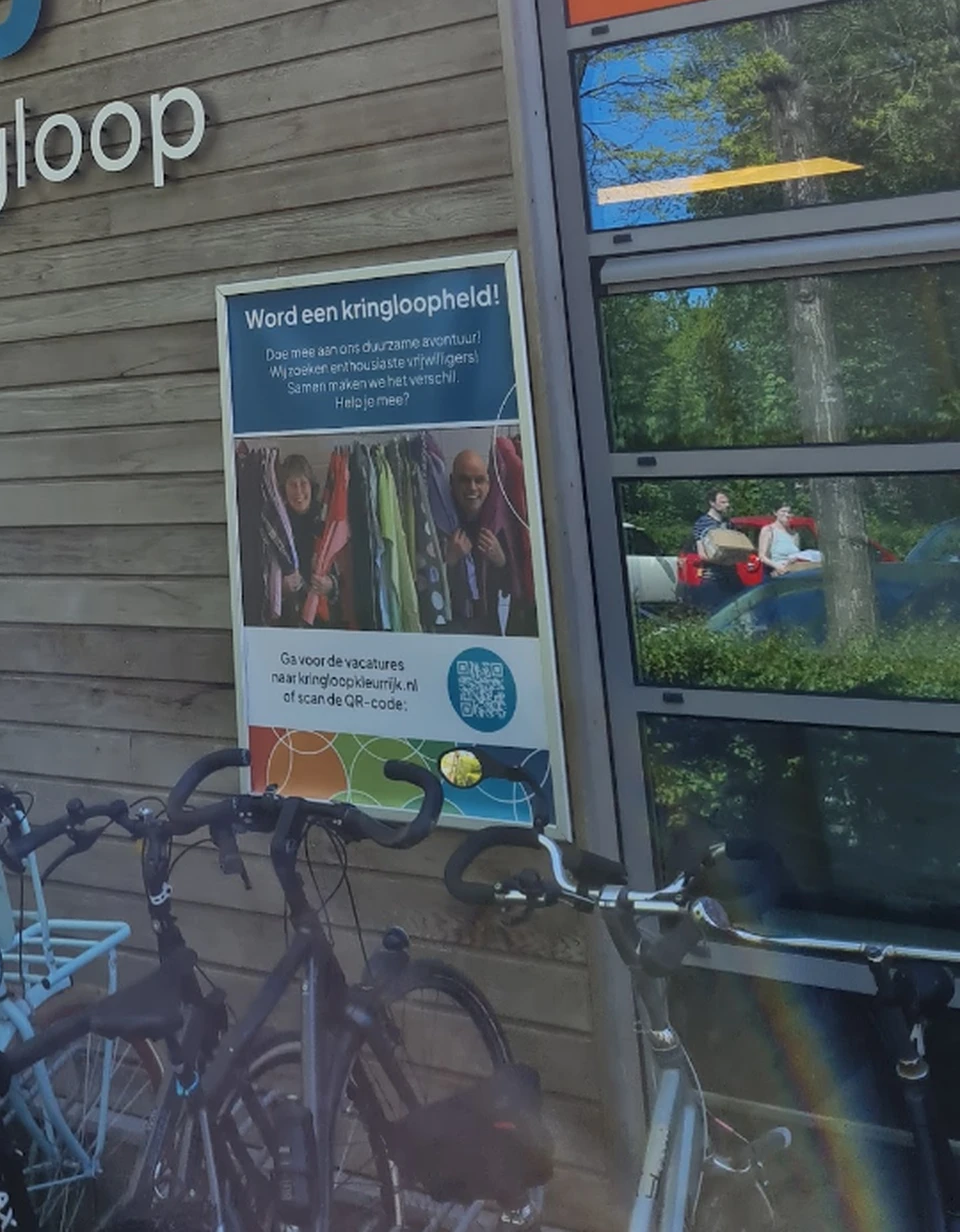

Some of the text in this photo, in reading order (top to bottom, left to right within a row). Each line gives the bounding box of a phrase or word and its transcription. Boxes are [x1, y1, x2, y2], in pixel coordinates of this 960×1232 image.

[245, 284, 500, 329] Word een kringloopheld!
[266, 330, 481, 361] Doe mee aan ons duurzame avontuur!
[270, 350, 479, 380] Wij zoeken enthousiaste vrijwilligers!
[287, 381, 326, 395] Samen
[328, 378, 367, 392] maken
[368, 377, 385, 389] we
[387, 374, 408, 387] het
[335, 391, 410, 412] Help je mee?
[280, 652, 405, 671] Ga voor de vacatures
[271, 672, 419, 694] naar kringloopkleurrijk.nl
[283, 690, 409, 712] of scan de QR-code:
